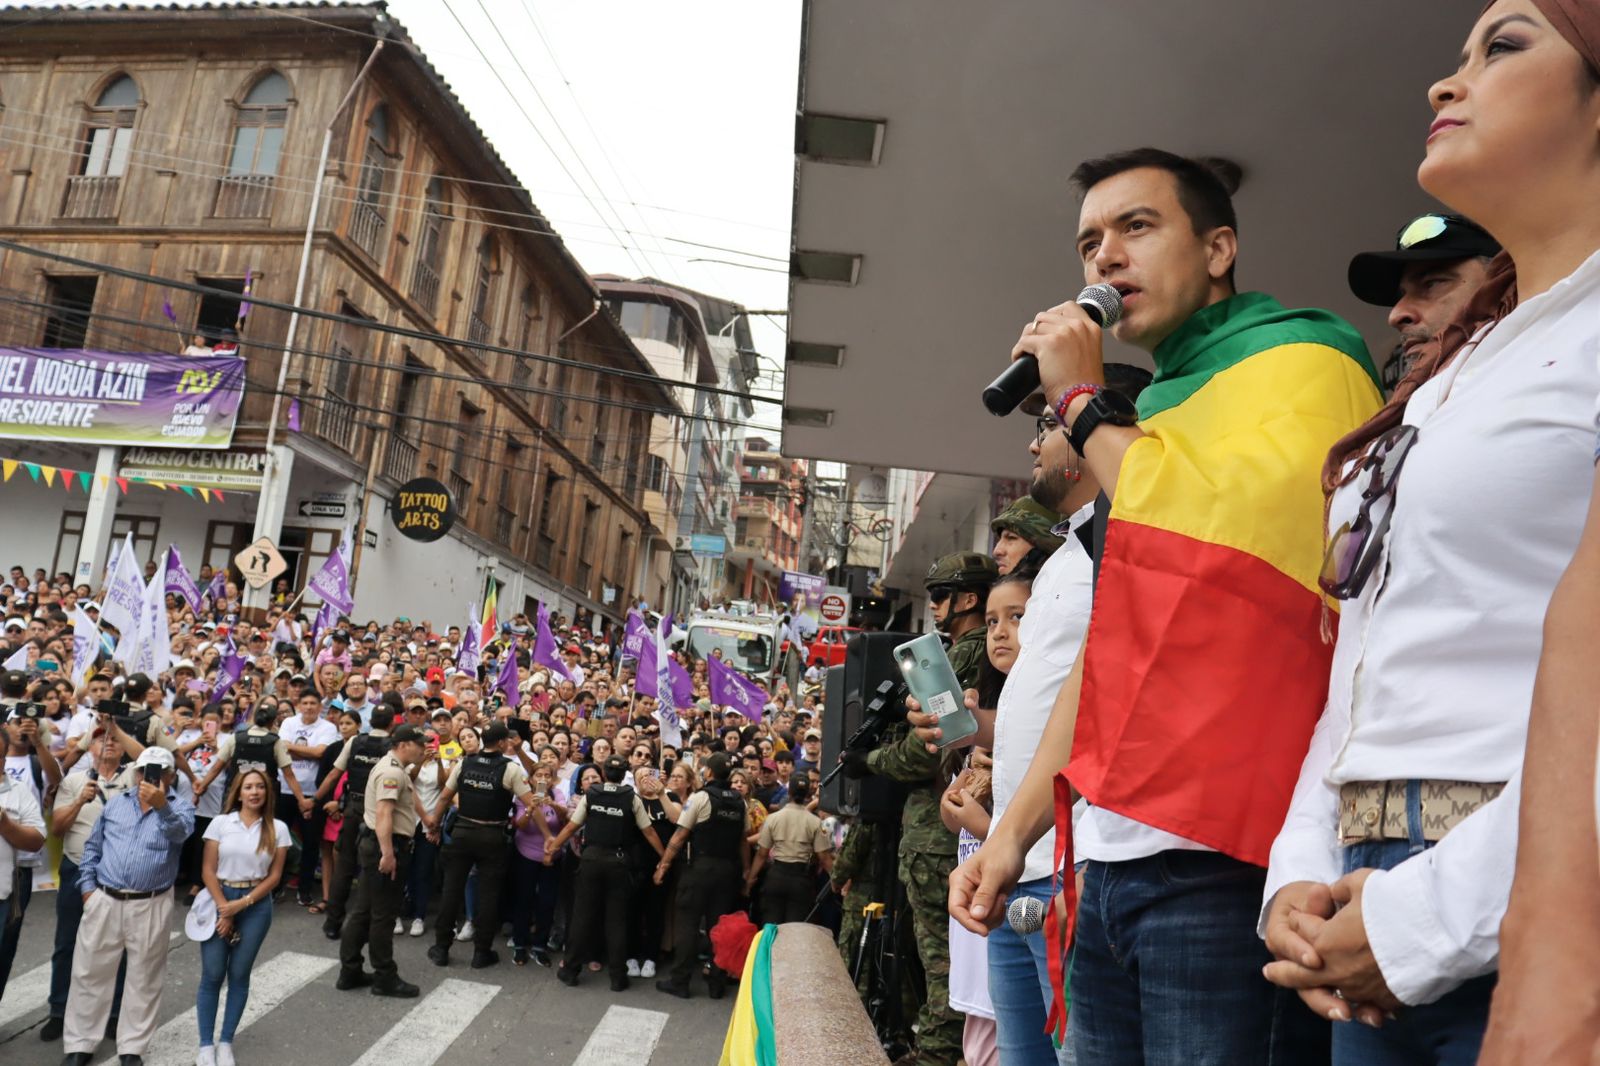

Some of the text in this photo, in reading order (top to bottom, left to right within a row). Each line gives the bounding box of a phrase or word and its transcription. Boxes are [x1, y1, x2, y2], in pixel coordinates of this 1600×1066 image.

[0, 355, 149, 400] IEL NOBOA AZIN
[123, 448, 265, 471] Abasto CENTRA
[399, 492, 447, 512] TATTOO
[399, 511, 440, 530] ARTS
[1428, 786, 1451, 800] MK
[1425, 815, 1450, 830] MK
